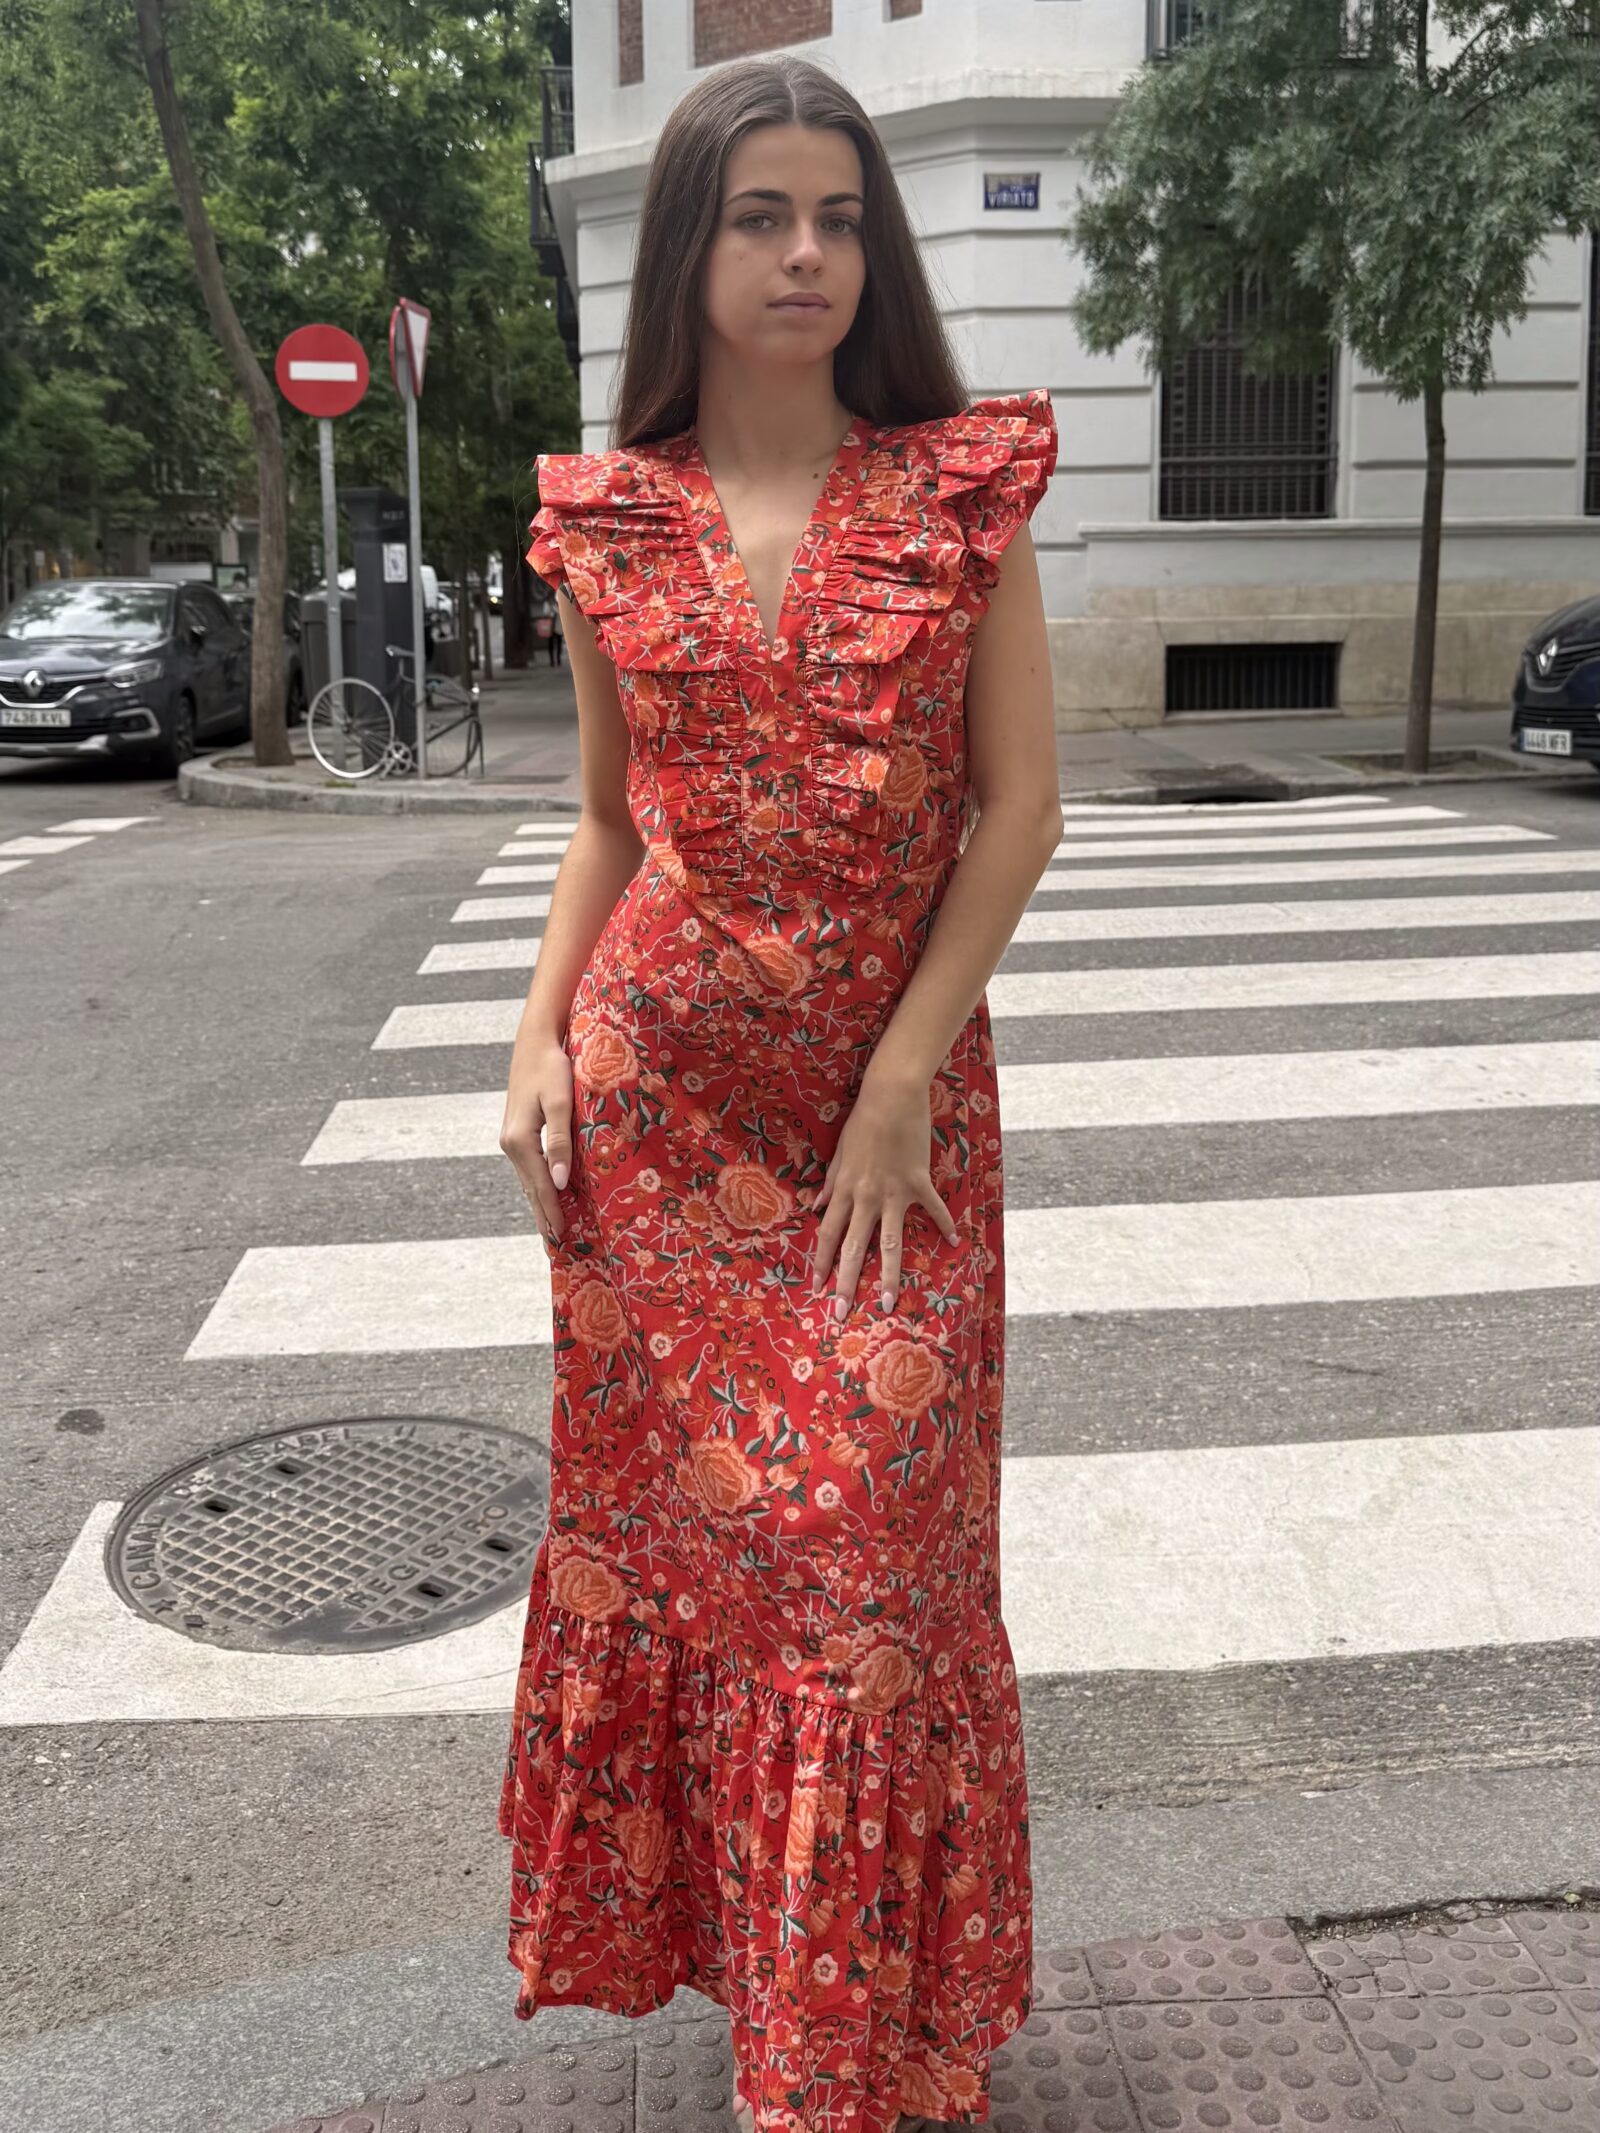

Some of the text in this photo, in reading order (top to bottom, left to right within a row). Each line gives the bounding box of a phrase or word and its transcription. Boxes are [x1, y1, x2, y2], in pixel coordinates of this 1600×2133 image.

[987, 191, 1035, 207] VIRIATO
[41, 712, 67, 724] KVL
[126, 1517, 166, 1590] CANAL
[236, 1427, 362, 1464] ISABEL
[343, 1504, 509, 1610] REGISTRO
